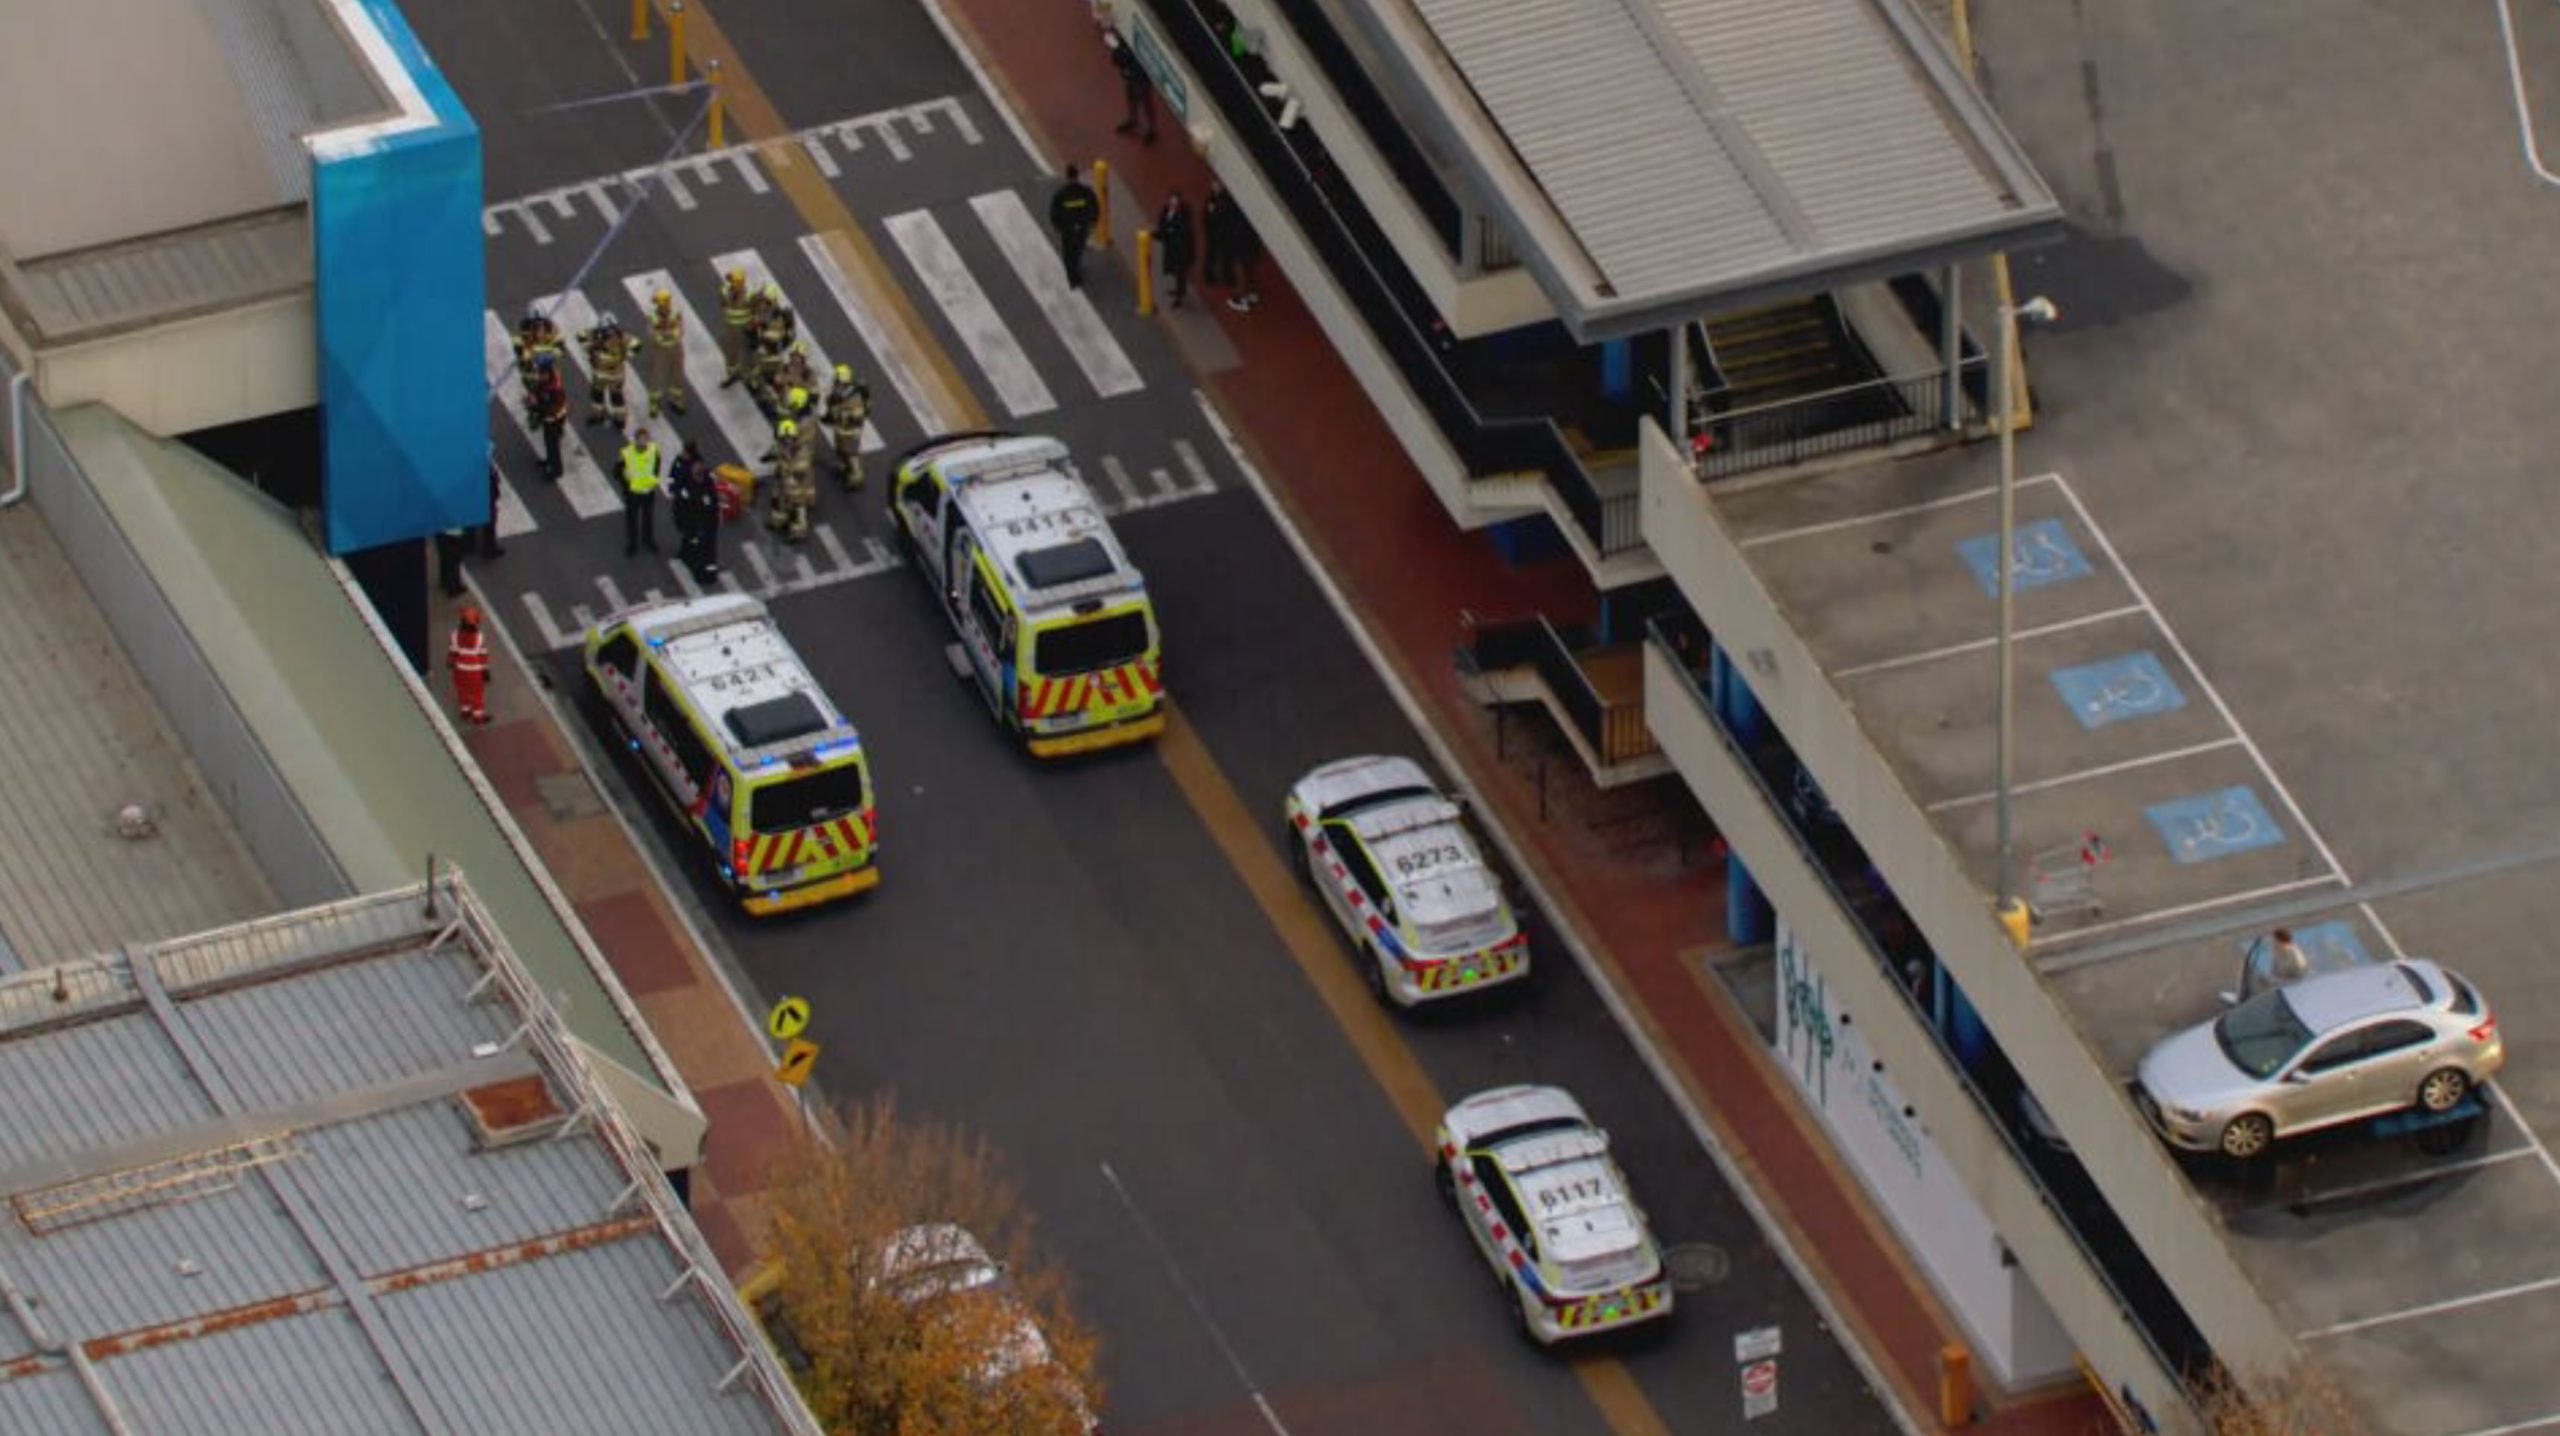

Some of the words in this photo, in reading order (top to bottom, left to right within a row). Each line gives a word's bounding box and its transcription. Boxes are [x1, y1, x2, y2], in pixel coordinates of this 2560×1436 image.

[1007, 510, 1074, 537] 6414
[711, 662, 776, 692] 6421
[1396, 845, 1461, 873] 6273
[1539, 1177, 1600, 1207] 6117
